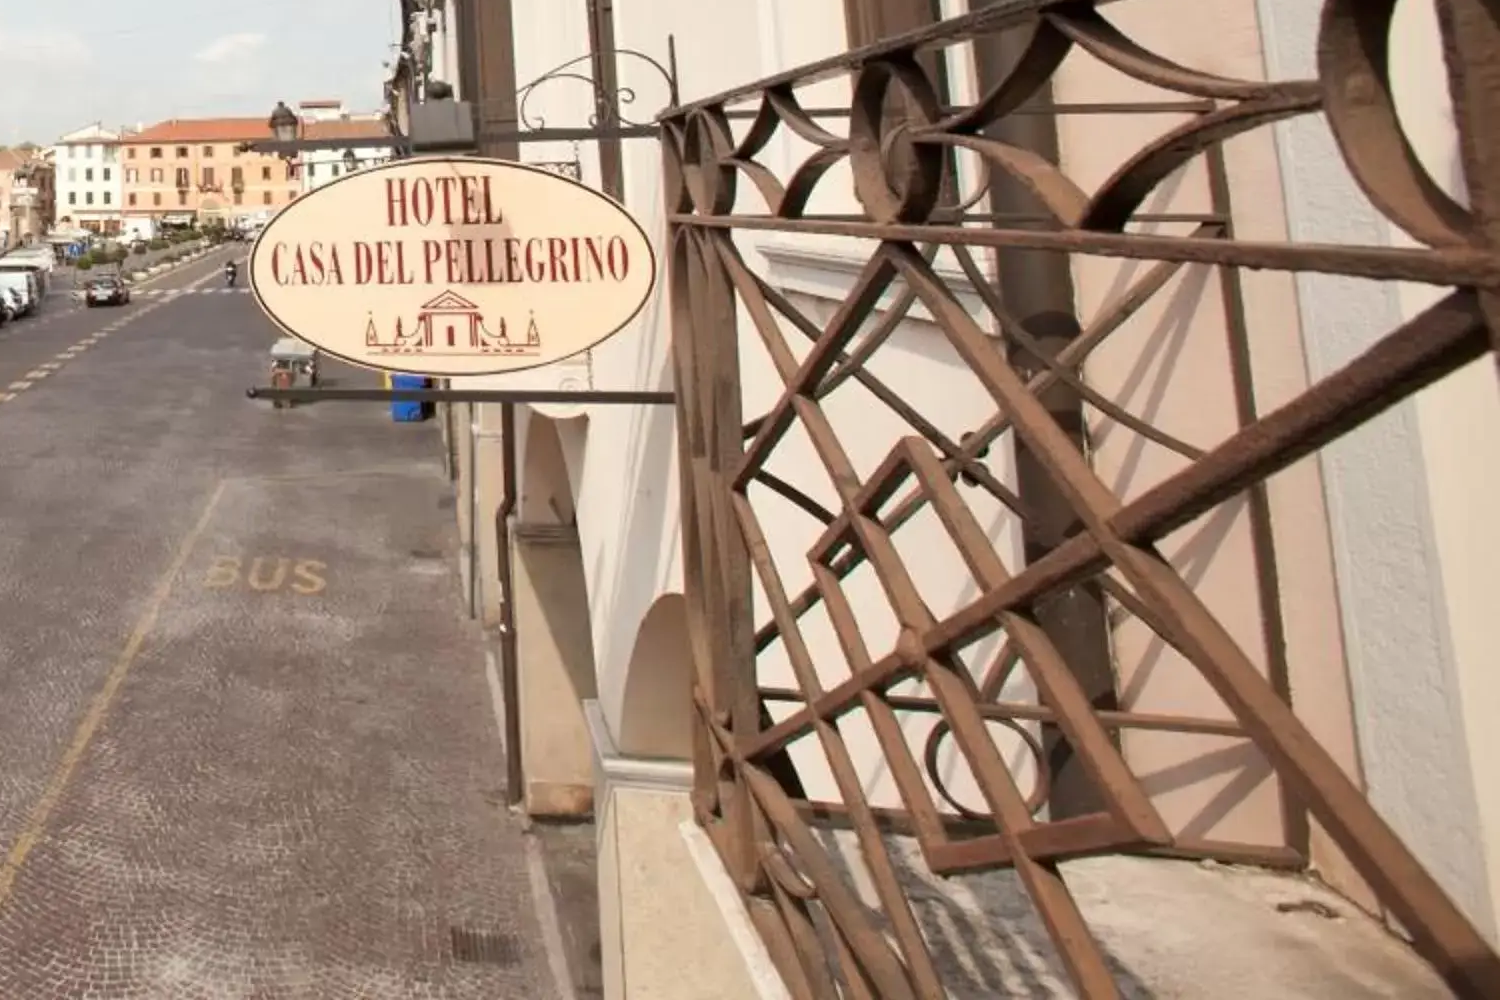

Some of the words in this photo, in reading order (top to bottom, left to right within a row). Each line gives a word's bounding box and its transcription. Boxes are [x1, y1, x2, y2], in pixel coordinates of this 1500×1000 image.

[384, 175, 503, 227] HOTEL
[271, 240, 345, 287] CASA
[353, 240, 415, 285] DEL
[423, 235, 630, 284] PELLEGRINO
[203, 554, 328, 595] BUS
